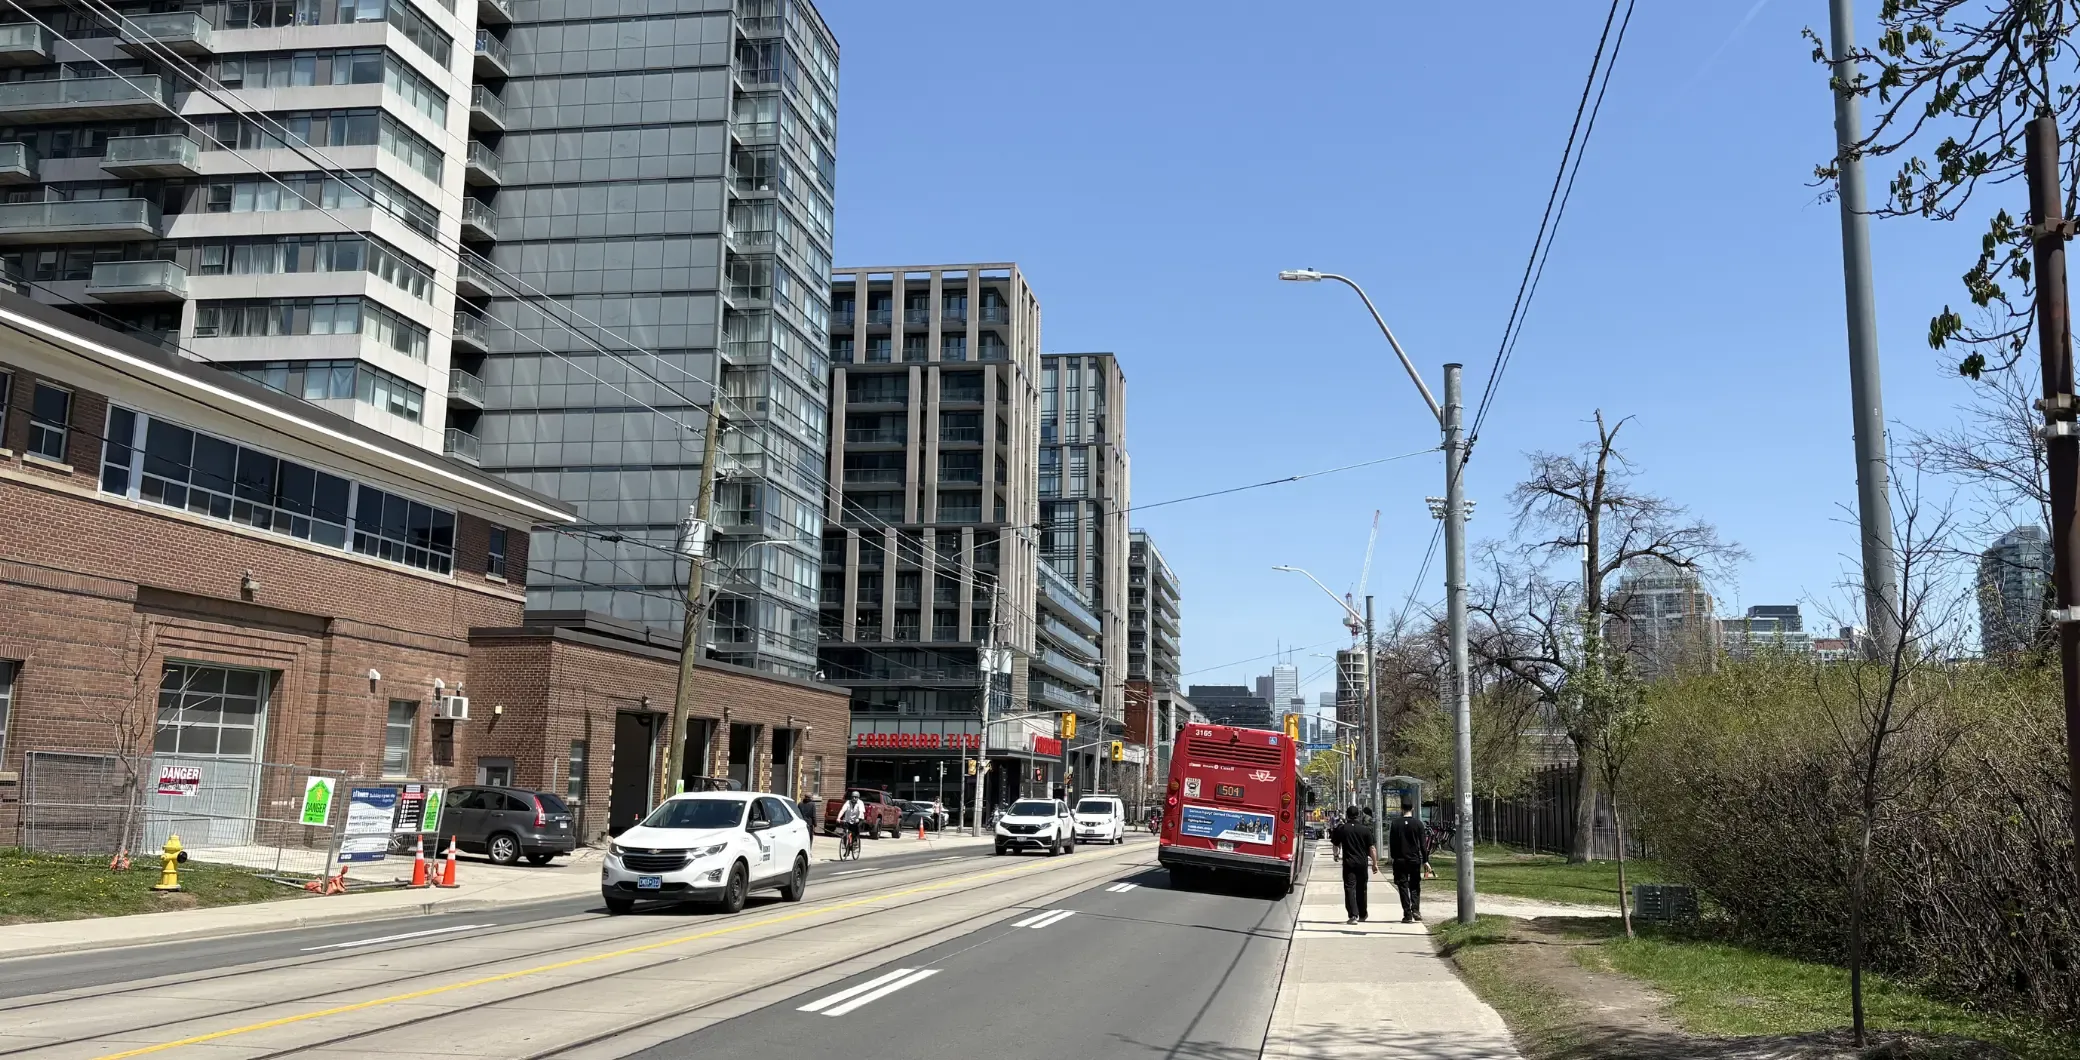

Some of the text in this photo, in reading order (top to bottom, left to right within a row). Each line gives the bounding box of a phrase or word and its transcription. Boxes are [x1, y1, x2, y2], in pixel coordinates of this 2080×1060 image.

[857, 733, 941, 749] CANADIAN
[162, 767, 199, 780] DANGER
[1222, 785, 1240, 797] 504
[305, 801, 327, 813] DANGER
